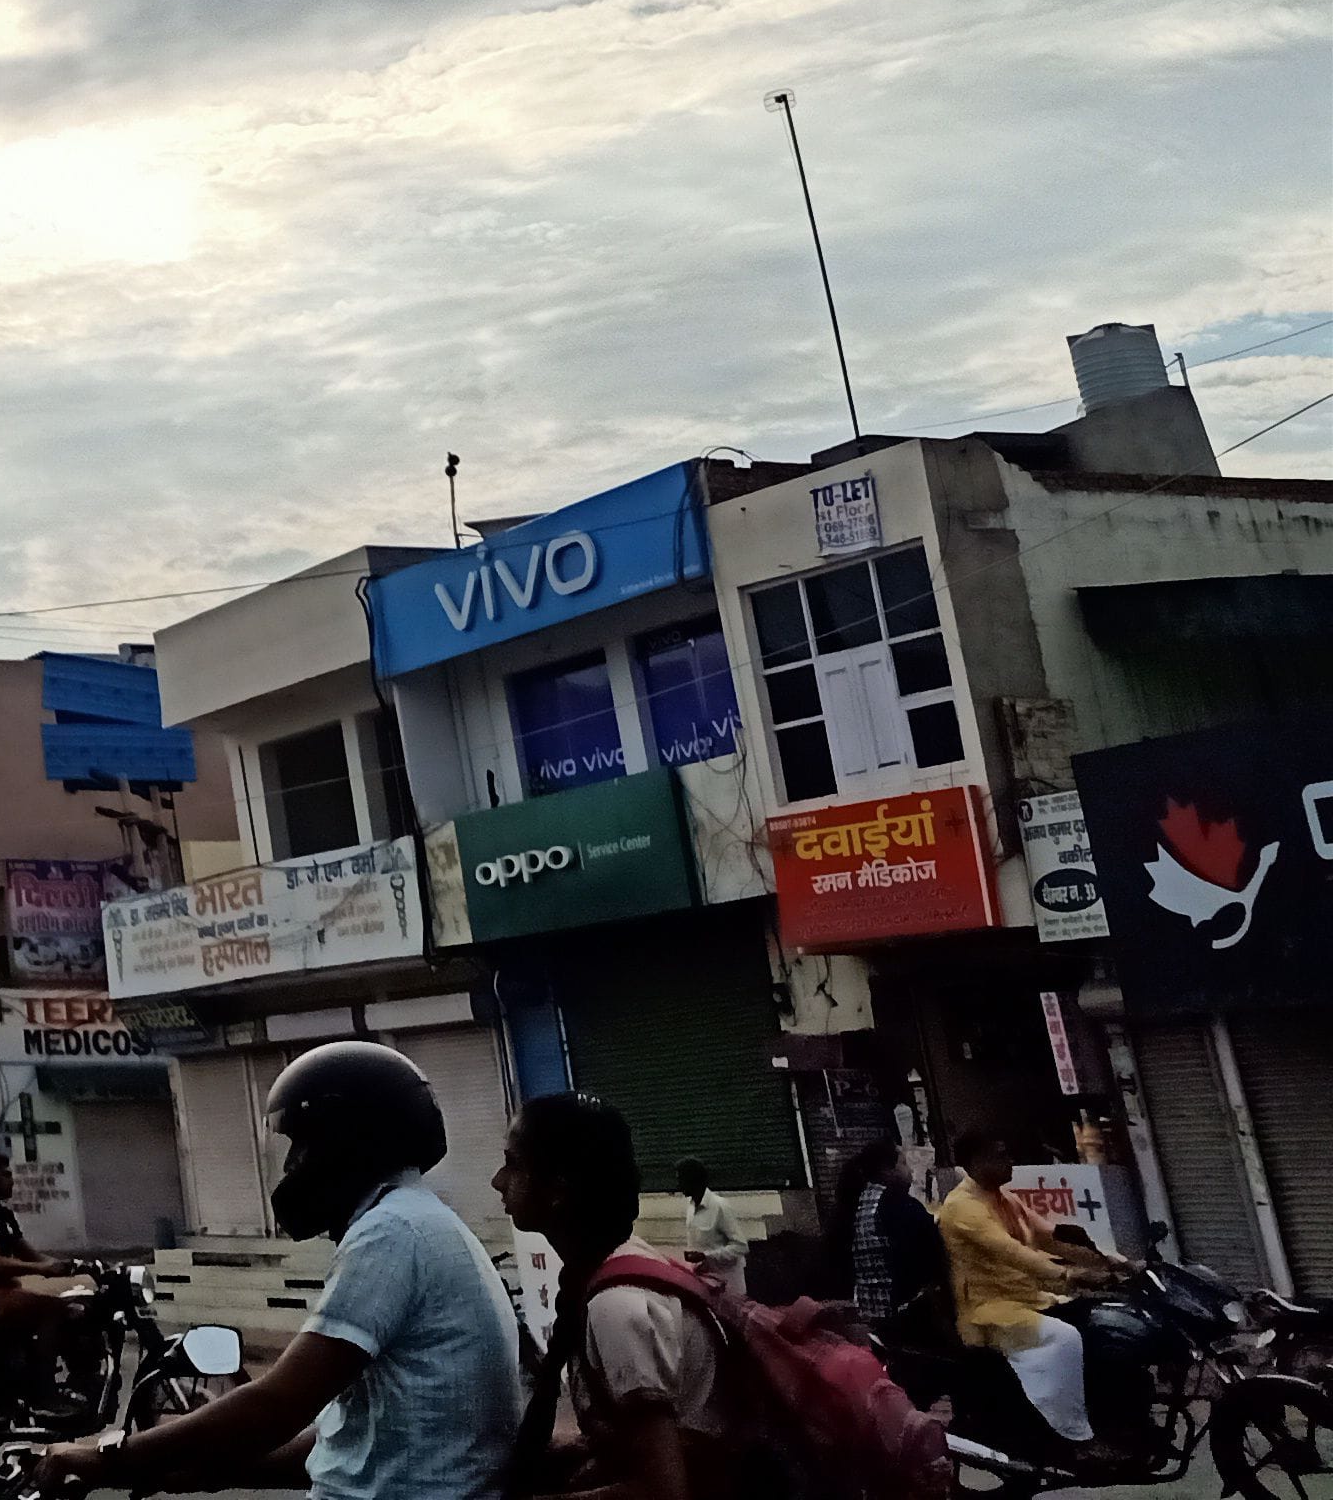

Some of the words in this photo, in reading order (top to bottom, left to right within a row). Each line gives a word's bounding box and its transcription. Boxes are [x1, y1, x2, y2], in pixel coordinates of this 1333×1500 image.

[810, 477, 870, 508] TO-LET
[434, 530, 597, 631] vivo
[793, 799, 937, 861] दवाईयां
[475, 845, 574, 888] oppo
[586, 842, 620, 859] Service
[620, 834, 652, 851] Center
[811, 871, 852, 896] रमन
[856, 856, 937, 889] मैडिकोज
[193, 871, 264, 917] भारत
[200, 932, 271, 977] हस्पताल
